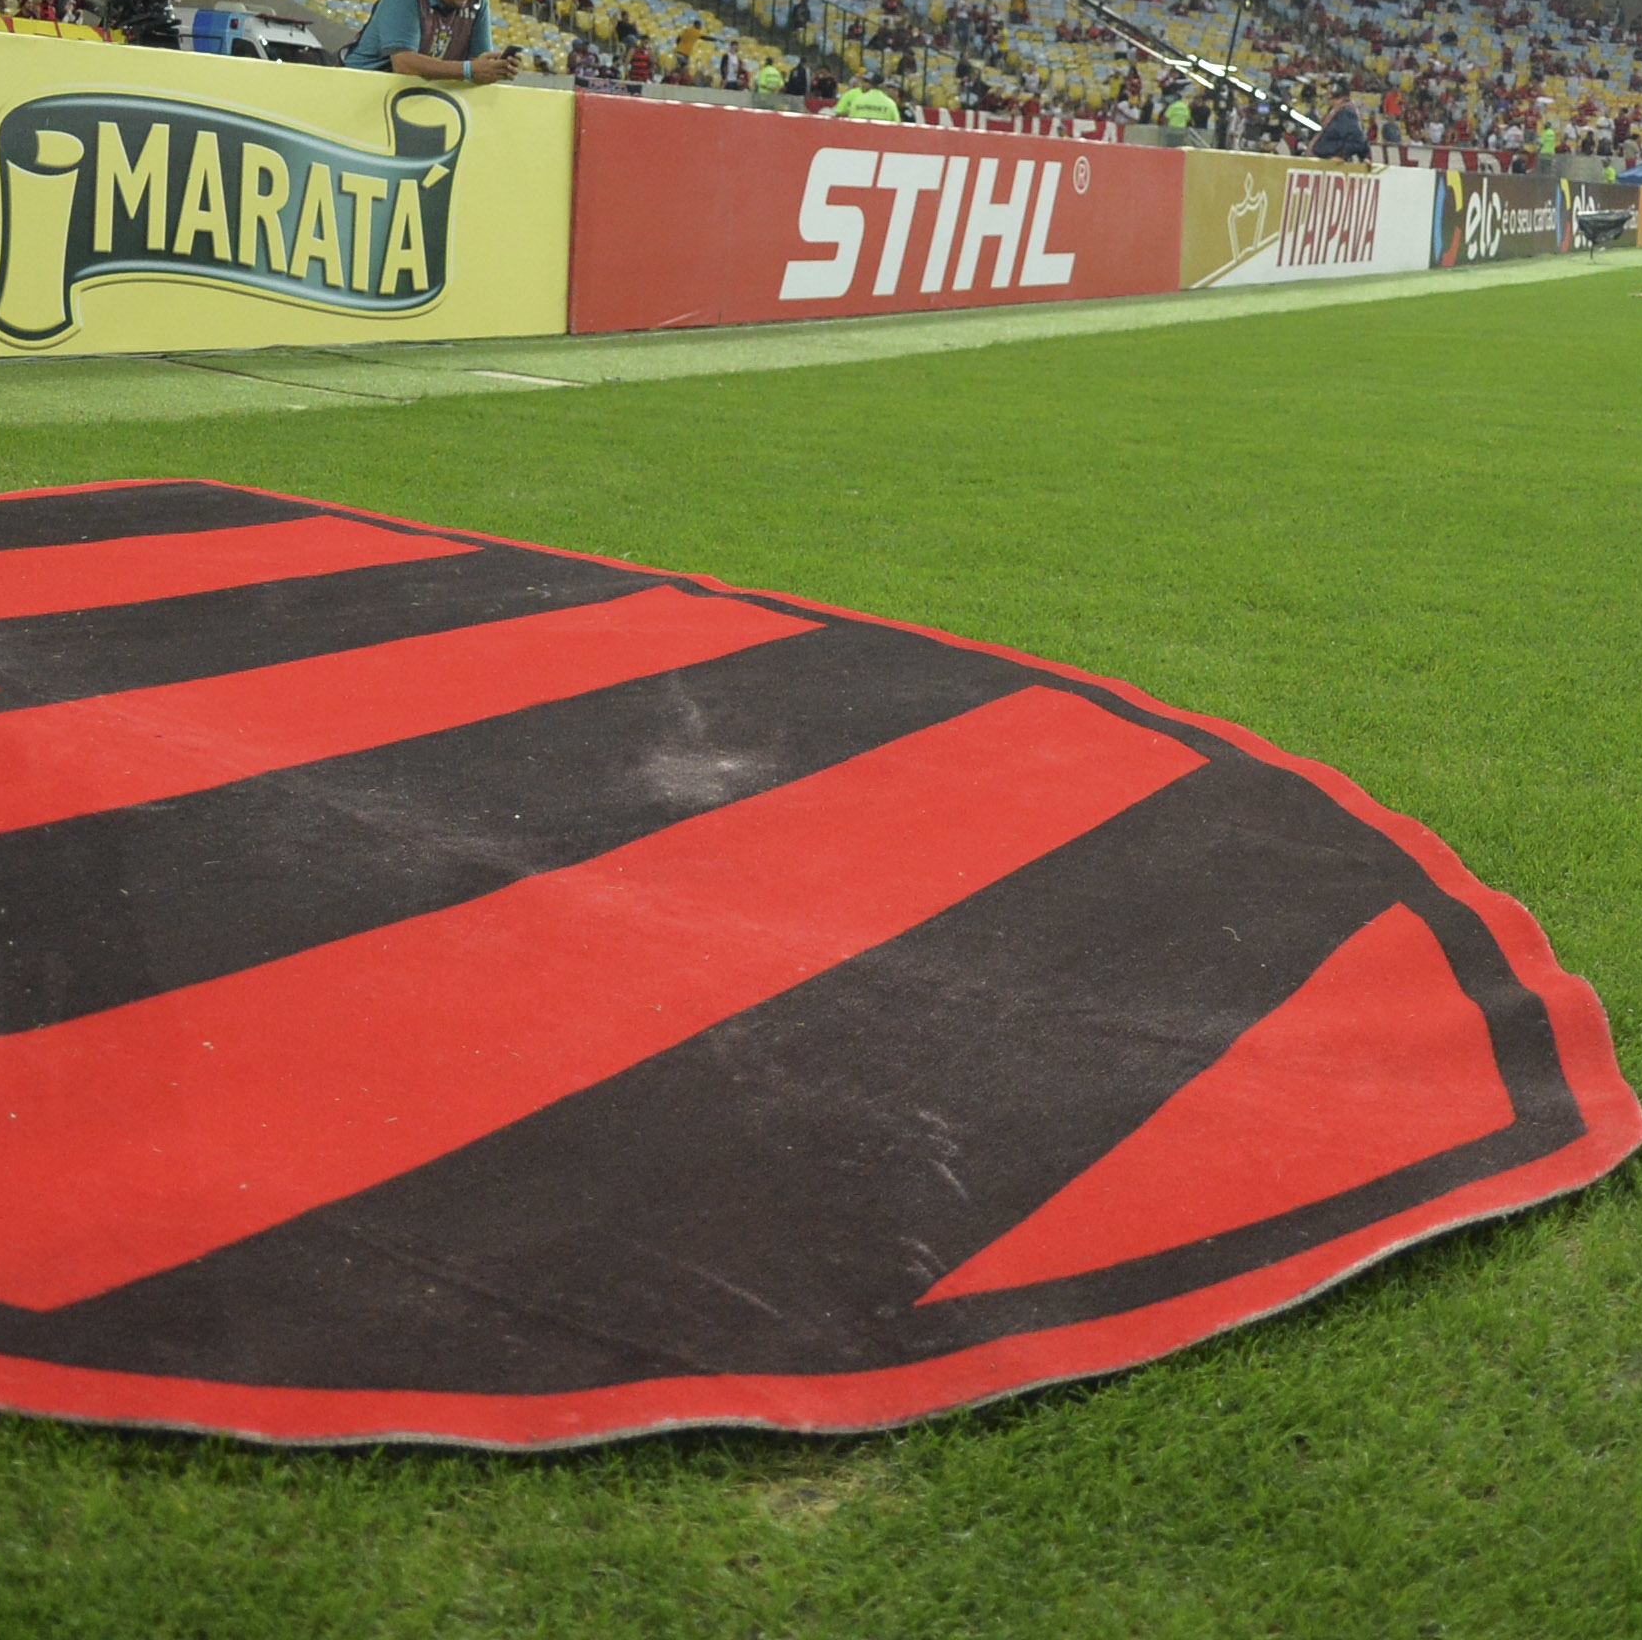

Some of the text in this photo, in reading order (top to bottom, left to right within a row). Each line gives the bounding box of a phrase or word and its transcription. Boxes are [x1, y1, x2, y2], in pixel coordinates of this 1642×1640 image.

[92, 120, 451, 294] MARATÁ
[778, 146, 1076, 301] STIHL
[1276, 169, 1381, 268] ITAIPAVA
[1509, 208, 1516, 234] o
